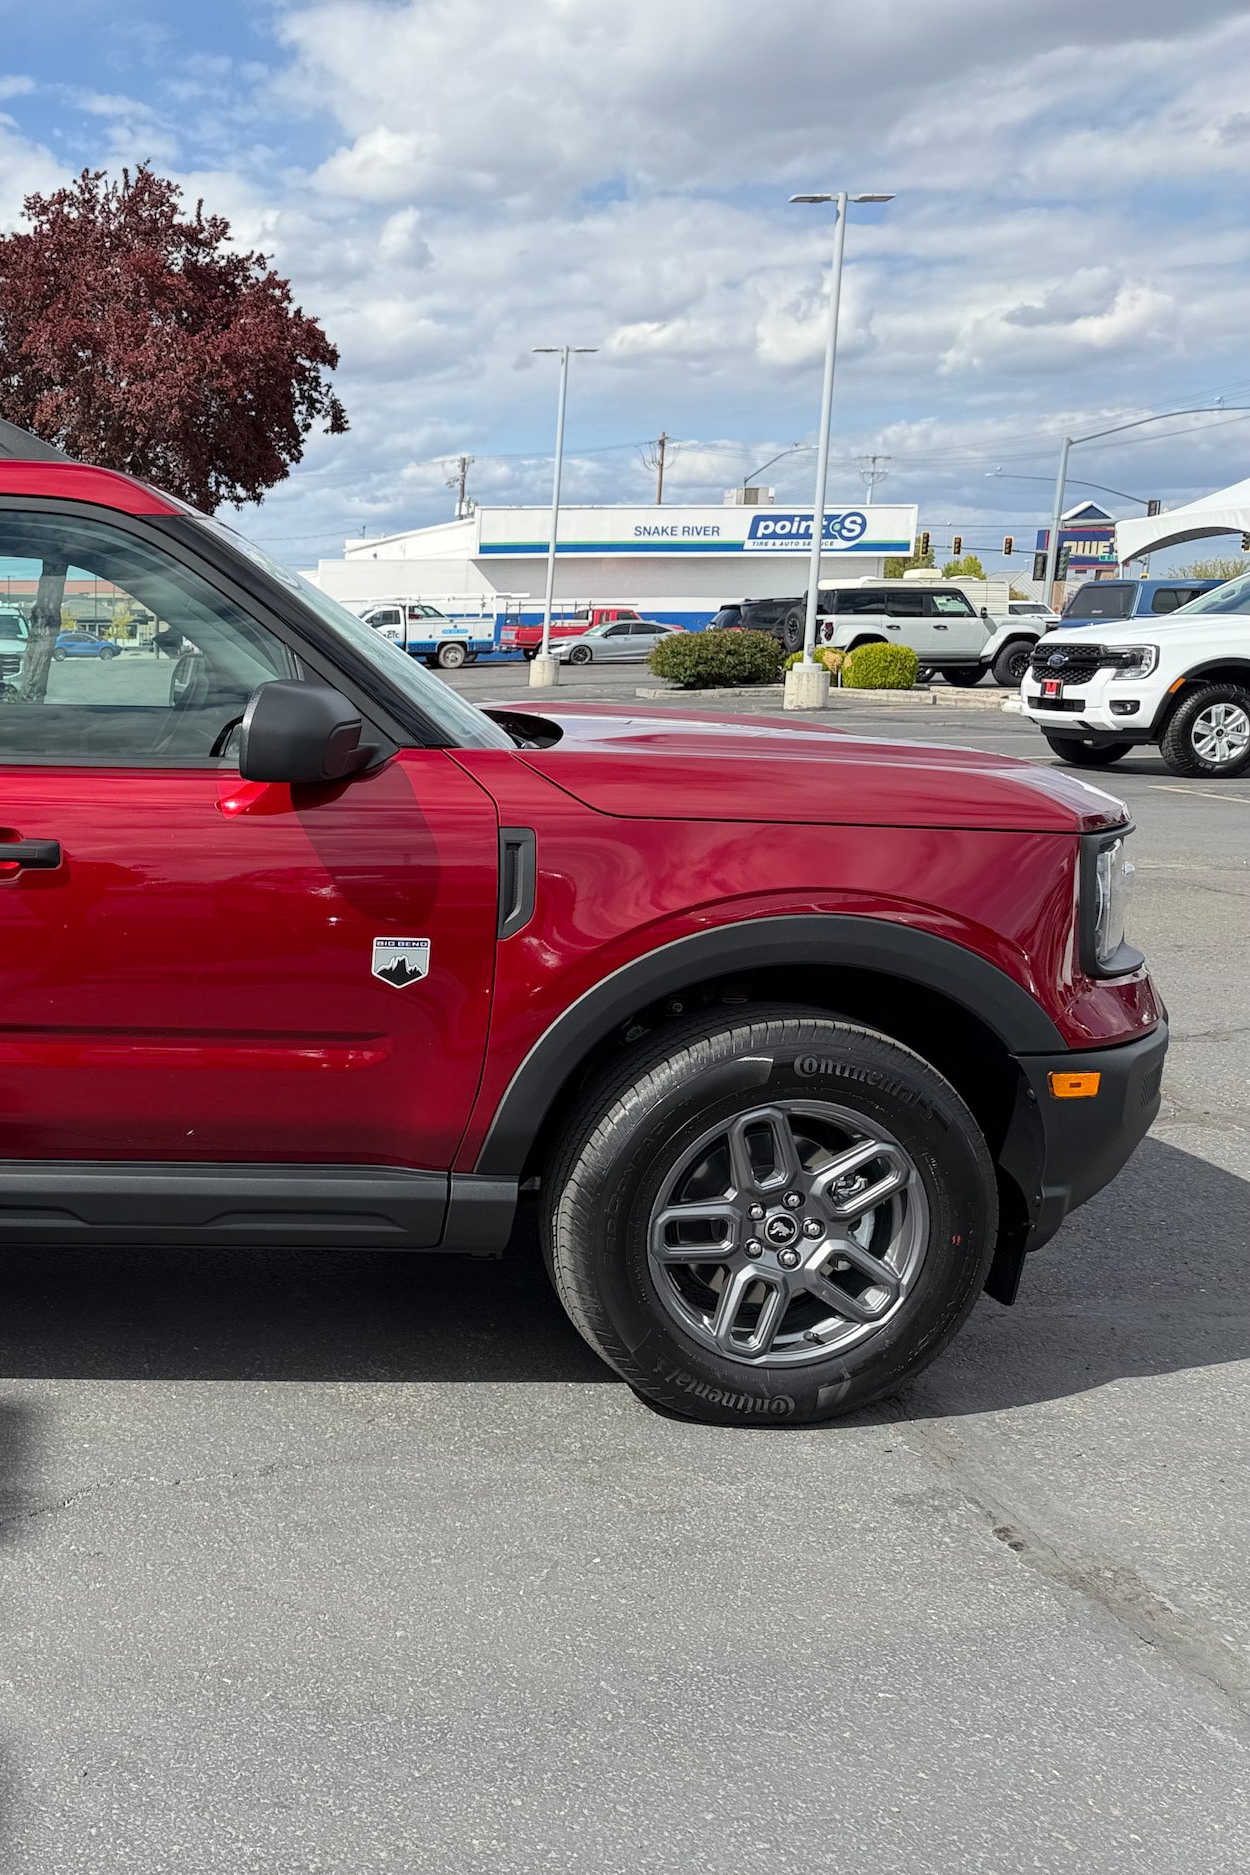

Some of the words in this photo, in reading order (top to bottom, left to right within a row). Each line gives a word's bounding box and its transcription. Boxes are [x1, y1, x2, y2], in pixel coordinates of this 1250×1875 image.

[634, 526, 677, 536] SNAKE
[682, 526, 720, 536] RIVER
[841, 516, 863, 537] S
[793, 1053, 927, 1109] Continental
[664, 1368, 796, 1416] Continental
